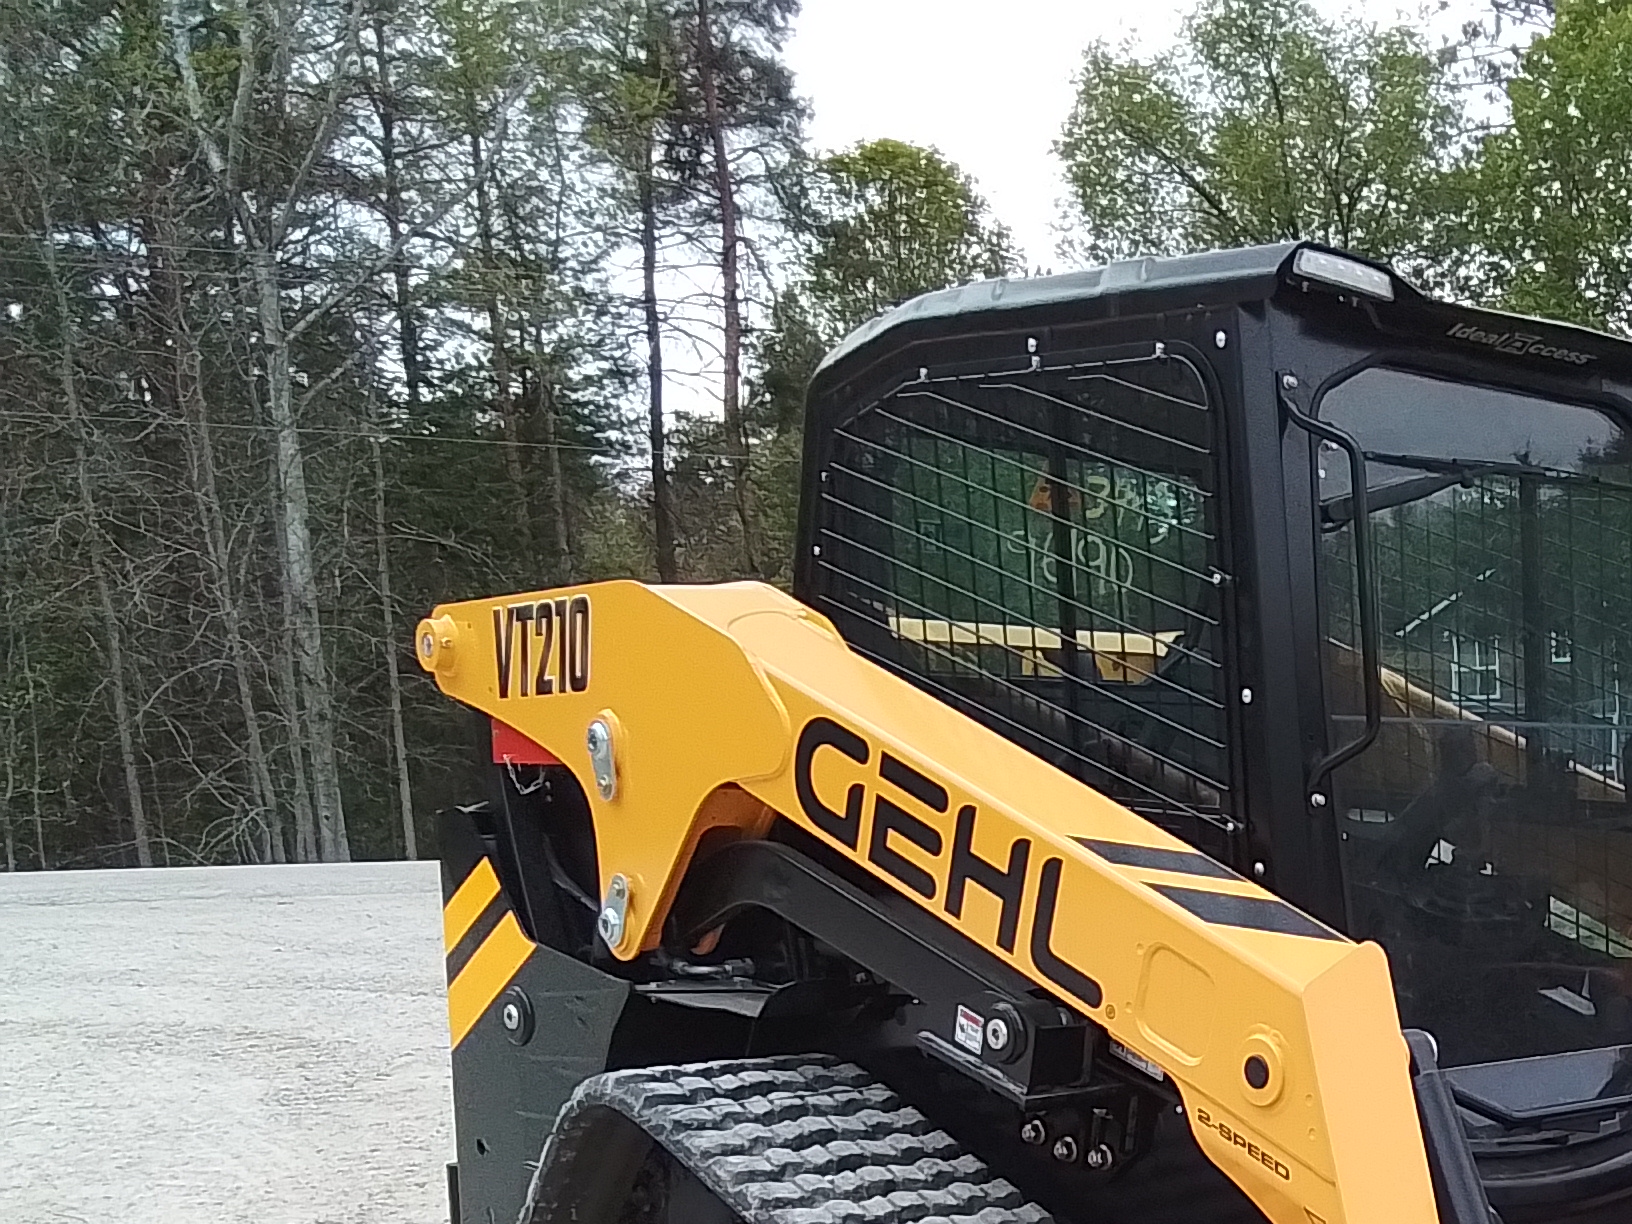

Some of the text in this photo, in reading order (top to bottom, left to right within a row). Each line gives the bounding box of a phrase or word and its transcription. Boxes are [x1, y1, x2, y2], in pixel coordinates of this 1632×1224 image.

[493, 595, 590, 699] VT210
[794, 715, 1103, 1009] GEHL
[1197, 1107, 1291, 1181] 2-SPEED
